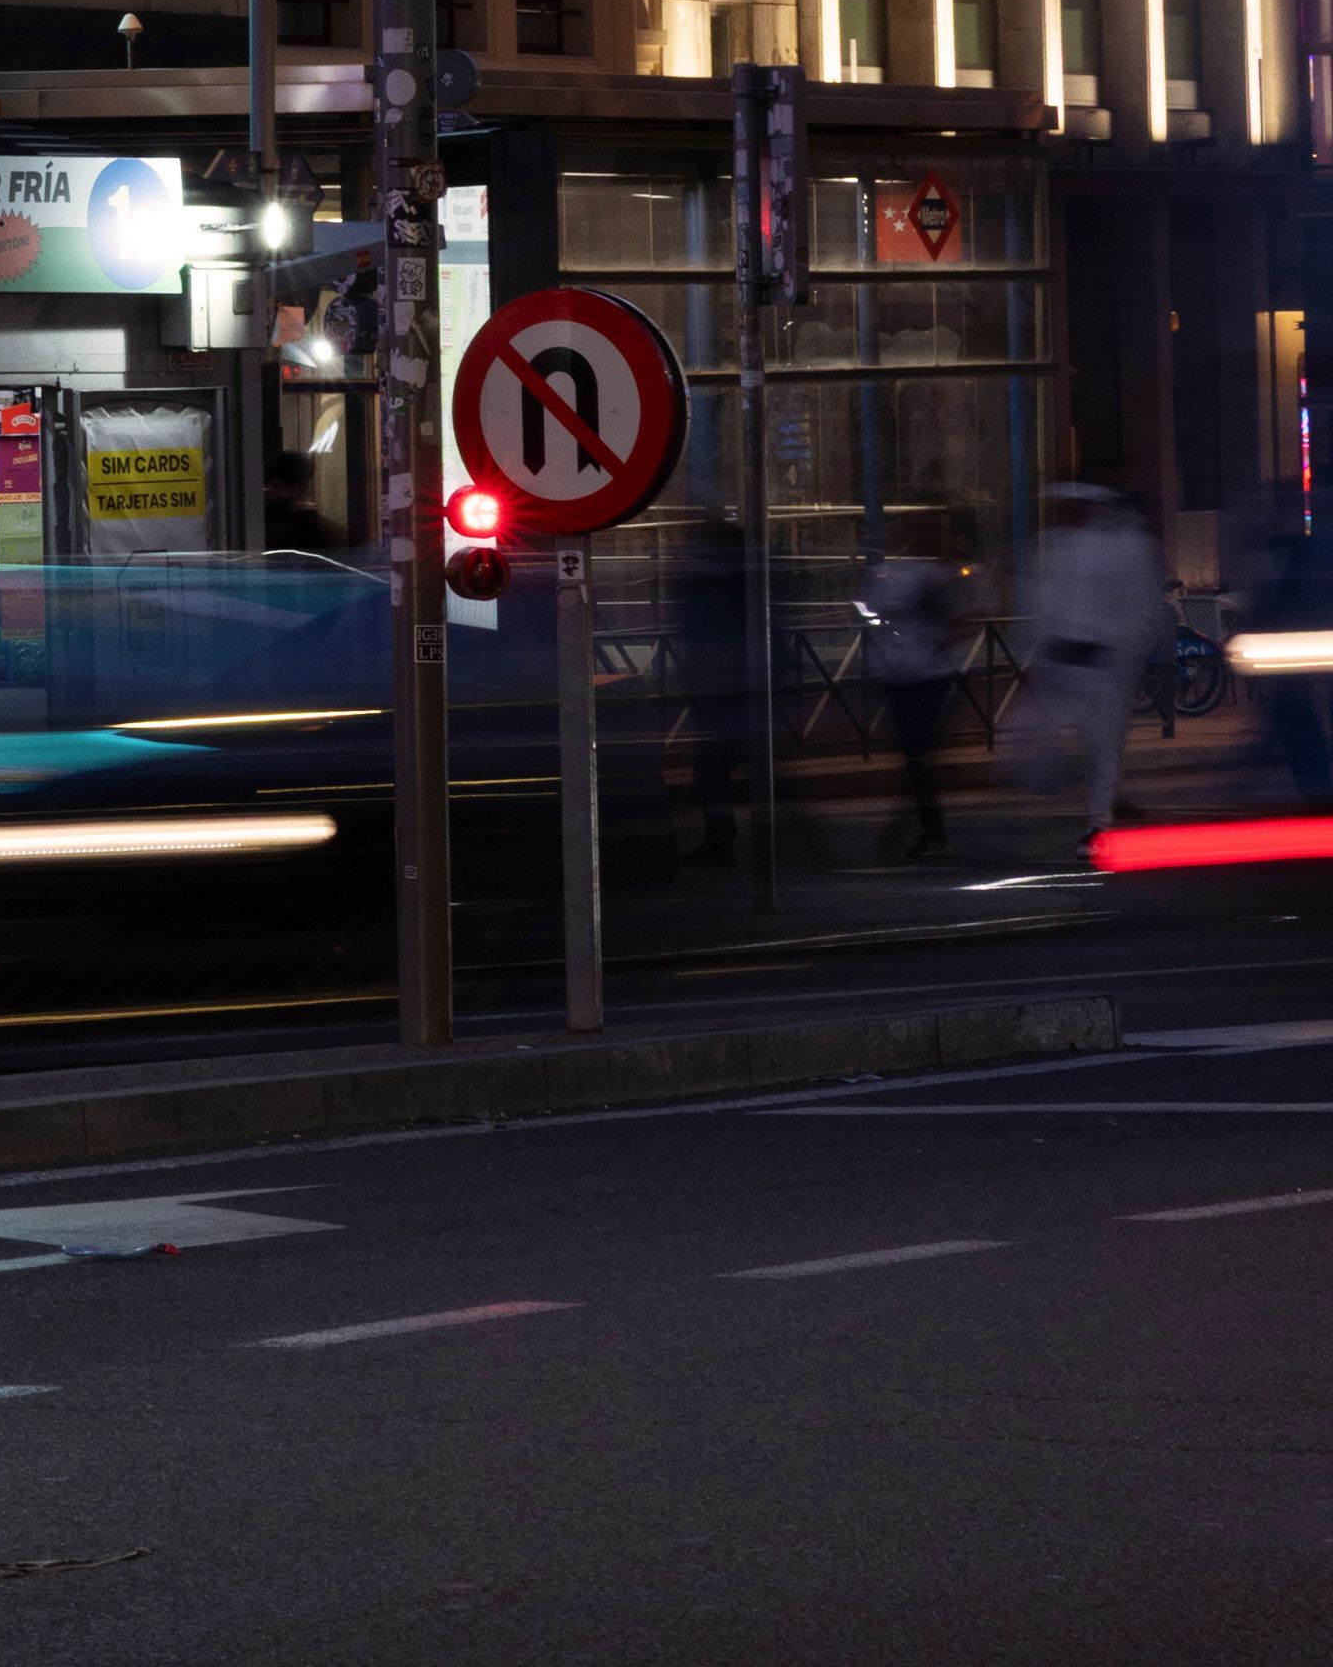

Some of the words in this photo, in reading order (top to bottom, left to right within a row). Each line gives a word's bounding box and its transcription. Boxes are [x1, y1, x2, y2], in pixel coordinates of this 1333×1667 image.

[8, 161, 71, 204] FRÍA
[101, 456, 131, 475] SIM
[134, 454, 190, 474] CARDS
[97, 492, 168, 511] TARJETAS
[170, 491, 196, 508] SIM
